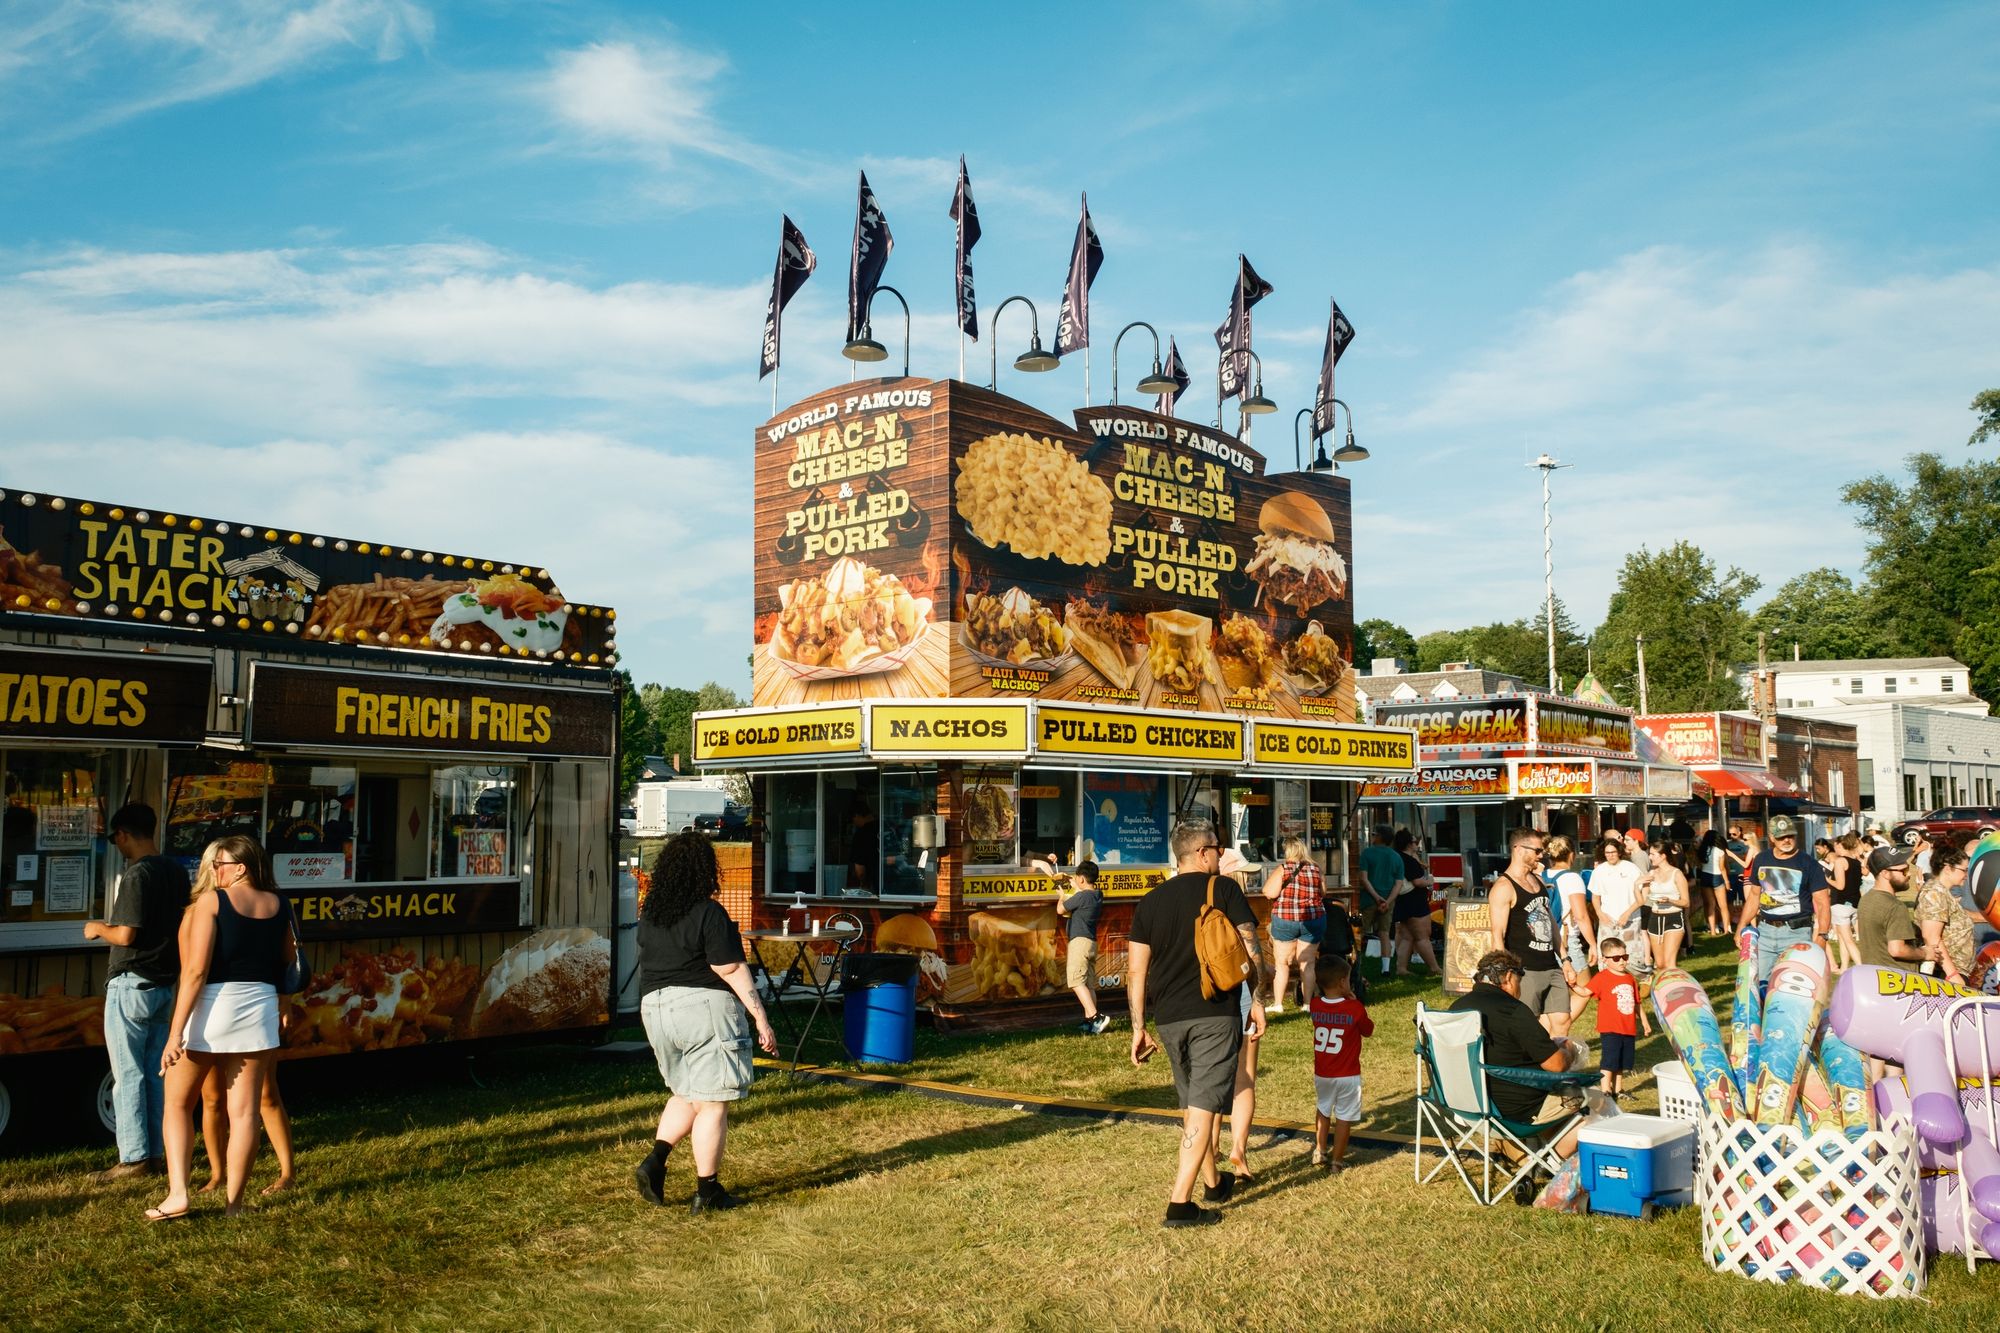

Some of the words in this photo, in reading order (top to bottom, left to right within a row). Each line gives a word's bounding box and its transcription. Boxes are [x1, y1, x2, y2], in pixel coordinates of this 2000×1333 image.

[768, 402, 839, 443] WORLD
[845, 390, 932, 414] FAMOUS
[796, 413, 899, 461] MAC-N
[1089, 418, 1168, 441] WORLD
[1174, 427, 1254, 475] FAMOUS
[788, 437, 908, 489] CHEESE
[1123, 443, 1226, 491] MAC-N
[839, 483, 854, 499] &
[1114, 471, 1235, 522] CHEESE
[786, 489, 910, 537] PULLED
[1170, 516, 1184, 534] &
[79, 520, 227, 577] TATER
[804, 520, 890, 561] PORK
[1113, 525, 1237, 572] PULLED
[72, 563, 241, 615] SHACK
[1133, 560, 1219, 599] PORK
[982, 666, 1014, 679] MAUI
[1018, 670, 1049, 682] WAUI
[991, 679, 1040, 691] NACHOS
[1077, 686, 1139, 700] PIGGYBACK
[1161, 692, 1179, 703] PIG
[1182, 694, 1198, 704] RIG
[1225, 698, 1243, 708] THE
[1245, 700, 1275, 711] STACK
[1300, 697, 1337, 707] REDNECK
[337, 687, 459, 739] FRENCH
[471, 697, 552, 745] FRIES
[1302, 705, 1335, 716] NACHOS
[704, 731, 729, 747] ICE
[735, 726, 780, 745] COLD
[786, 721, 856, 743] DRINKS
[890, 719, 1009, 739] NACHOS
[1457, 708, 1521, 737] STEAK
[1044, 719, 1137, 744] PULLED
[1145, 726, 1237, 750] CHICKEN
[1664, 730, 1714, 744] CHICKEN
[1260, 734, 1290, 753] ICE
[1296, 736, 1341, 756] COLD
[1348, 739, 1408, 759] DRINKS
[1421, 768, 1498, 783] SAUSAGE
[1521, 775, 1556, 790] CORN
[1555, 769, 1591, 788] DOGS
[1380, 785, 1398, 794] with
[1439, 783, 1473, 793] Peppers
[975, 845, 1001, 853] NAPKINS
[288, 858, 301, 866] NO
[303, 857, 333, 865] SERVICE
[963, 879, 1048, 894] LEMONADE
[1112, 882, 1143, 891] DRINKS
[1113, 874, 1141, 882] SERVE
[368, 893, 457, 919] SHACK
[1314, 1026, 1345, 1055] 95
